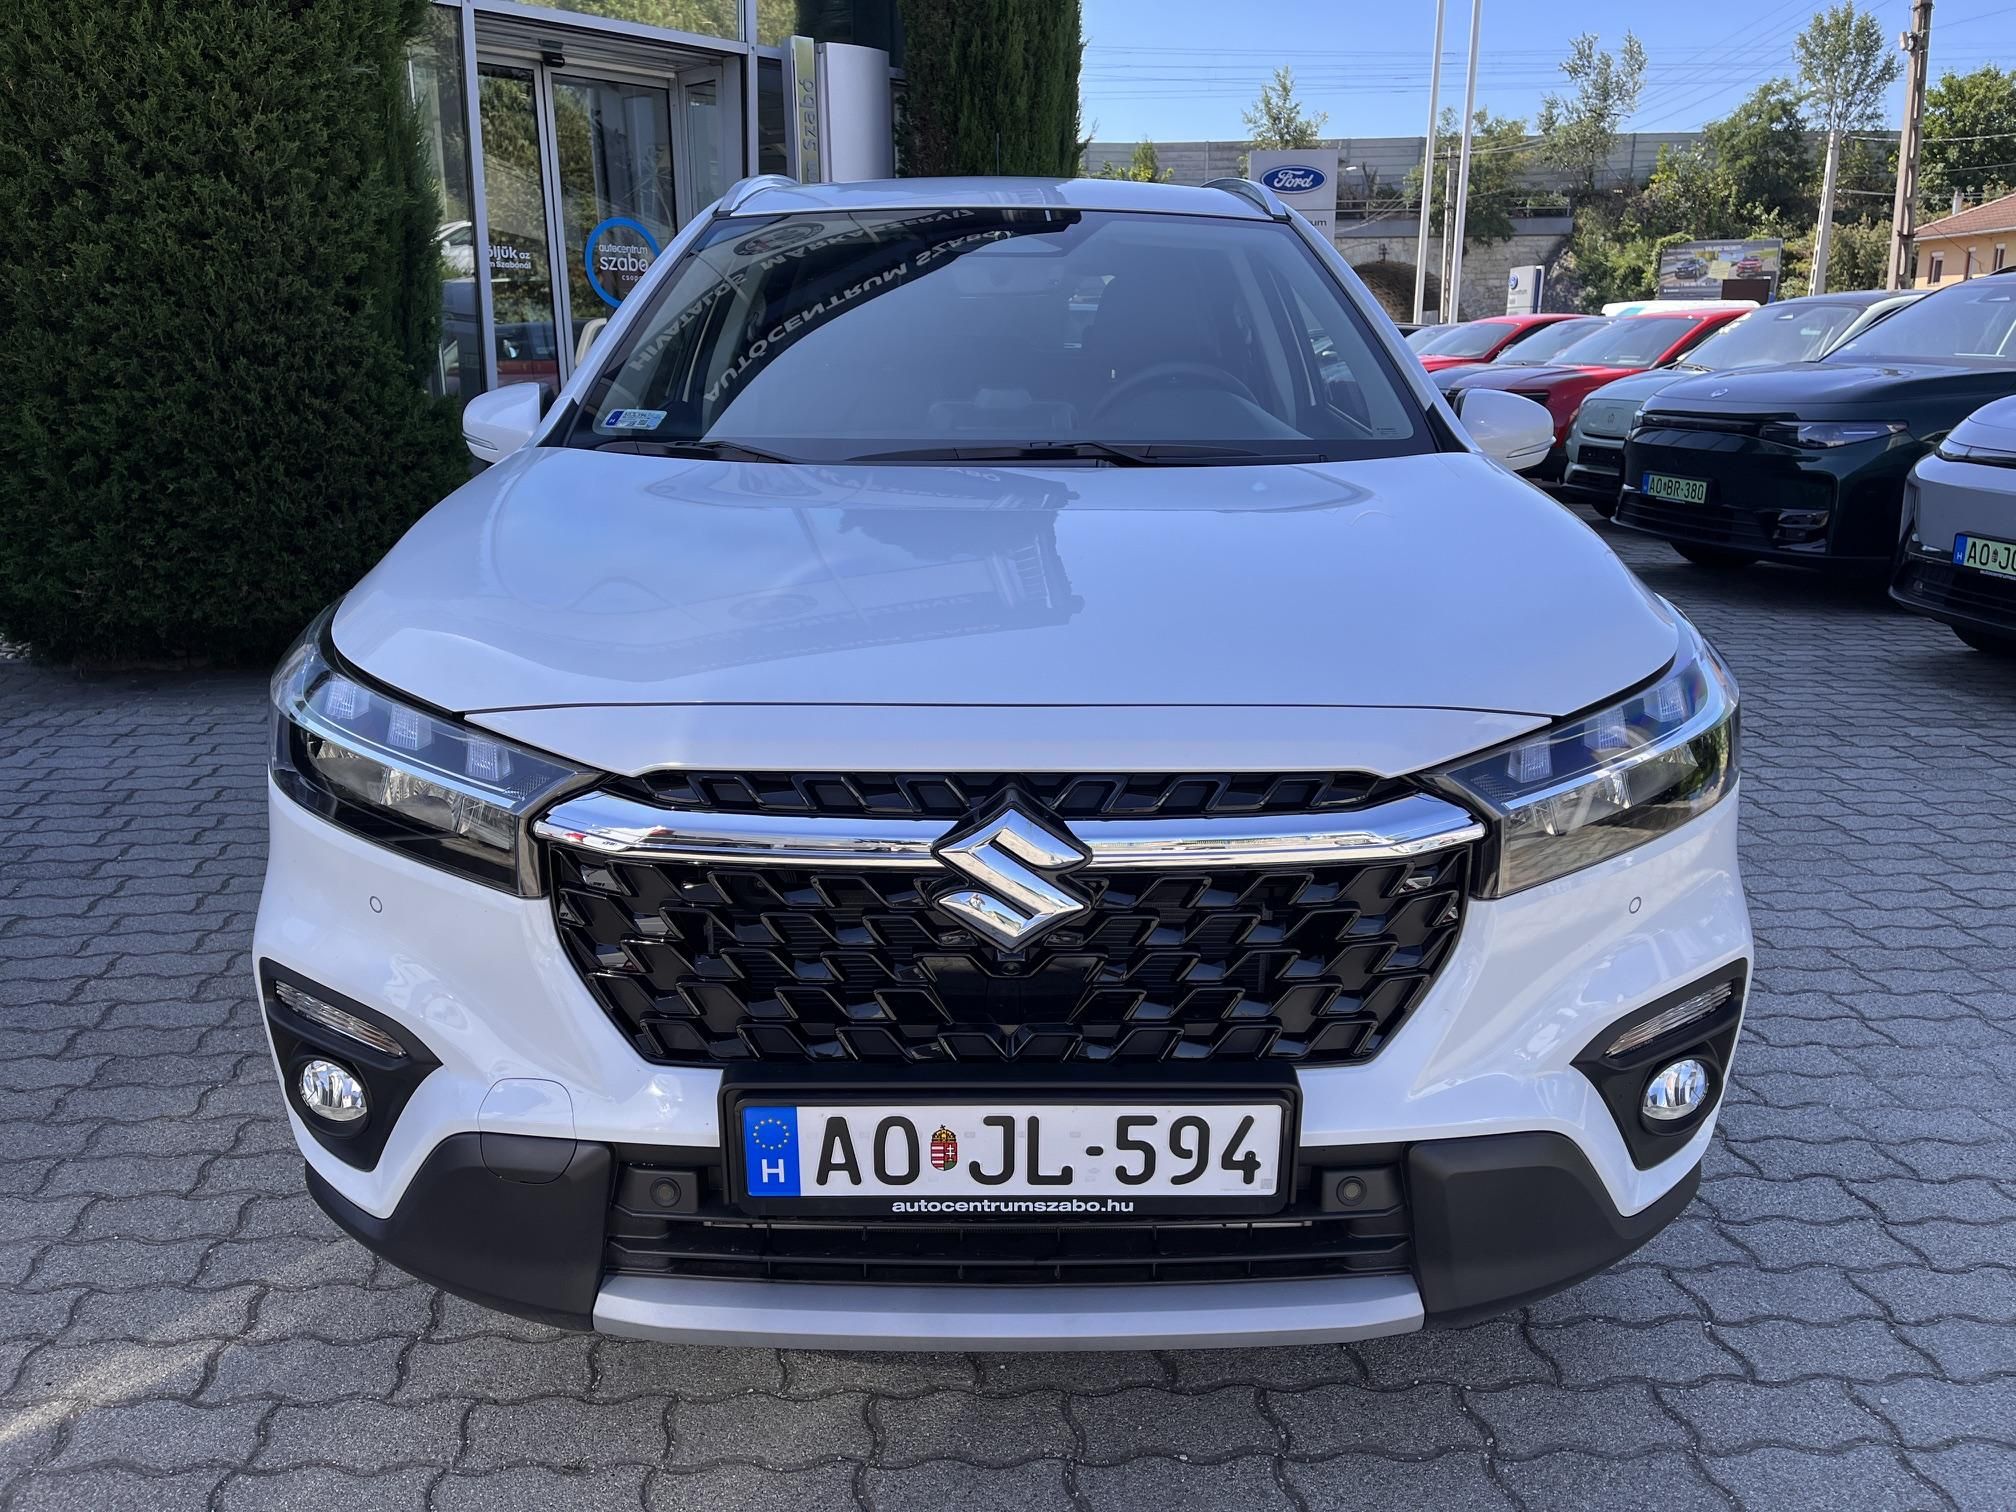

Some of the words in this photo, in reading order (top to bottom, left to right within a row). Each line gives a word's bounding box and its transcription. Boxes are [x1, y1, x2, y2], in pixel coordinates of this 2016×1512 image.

[1273, 169, 1314, 188] Ford
[761, 1157, 785, 1184] H
[891, 1198, 1134, 1214] autocentrumszabo.hu
